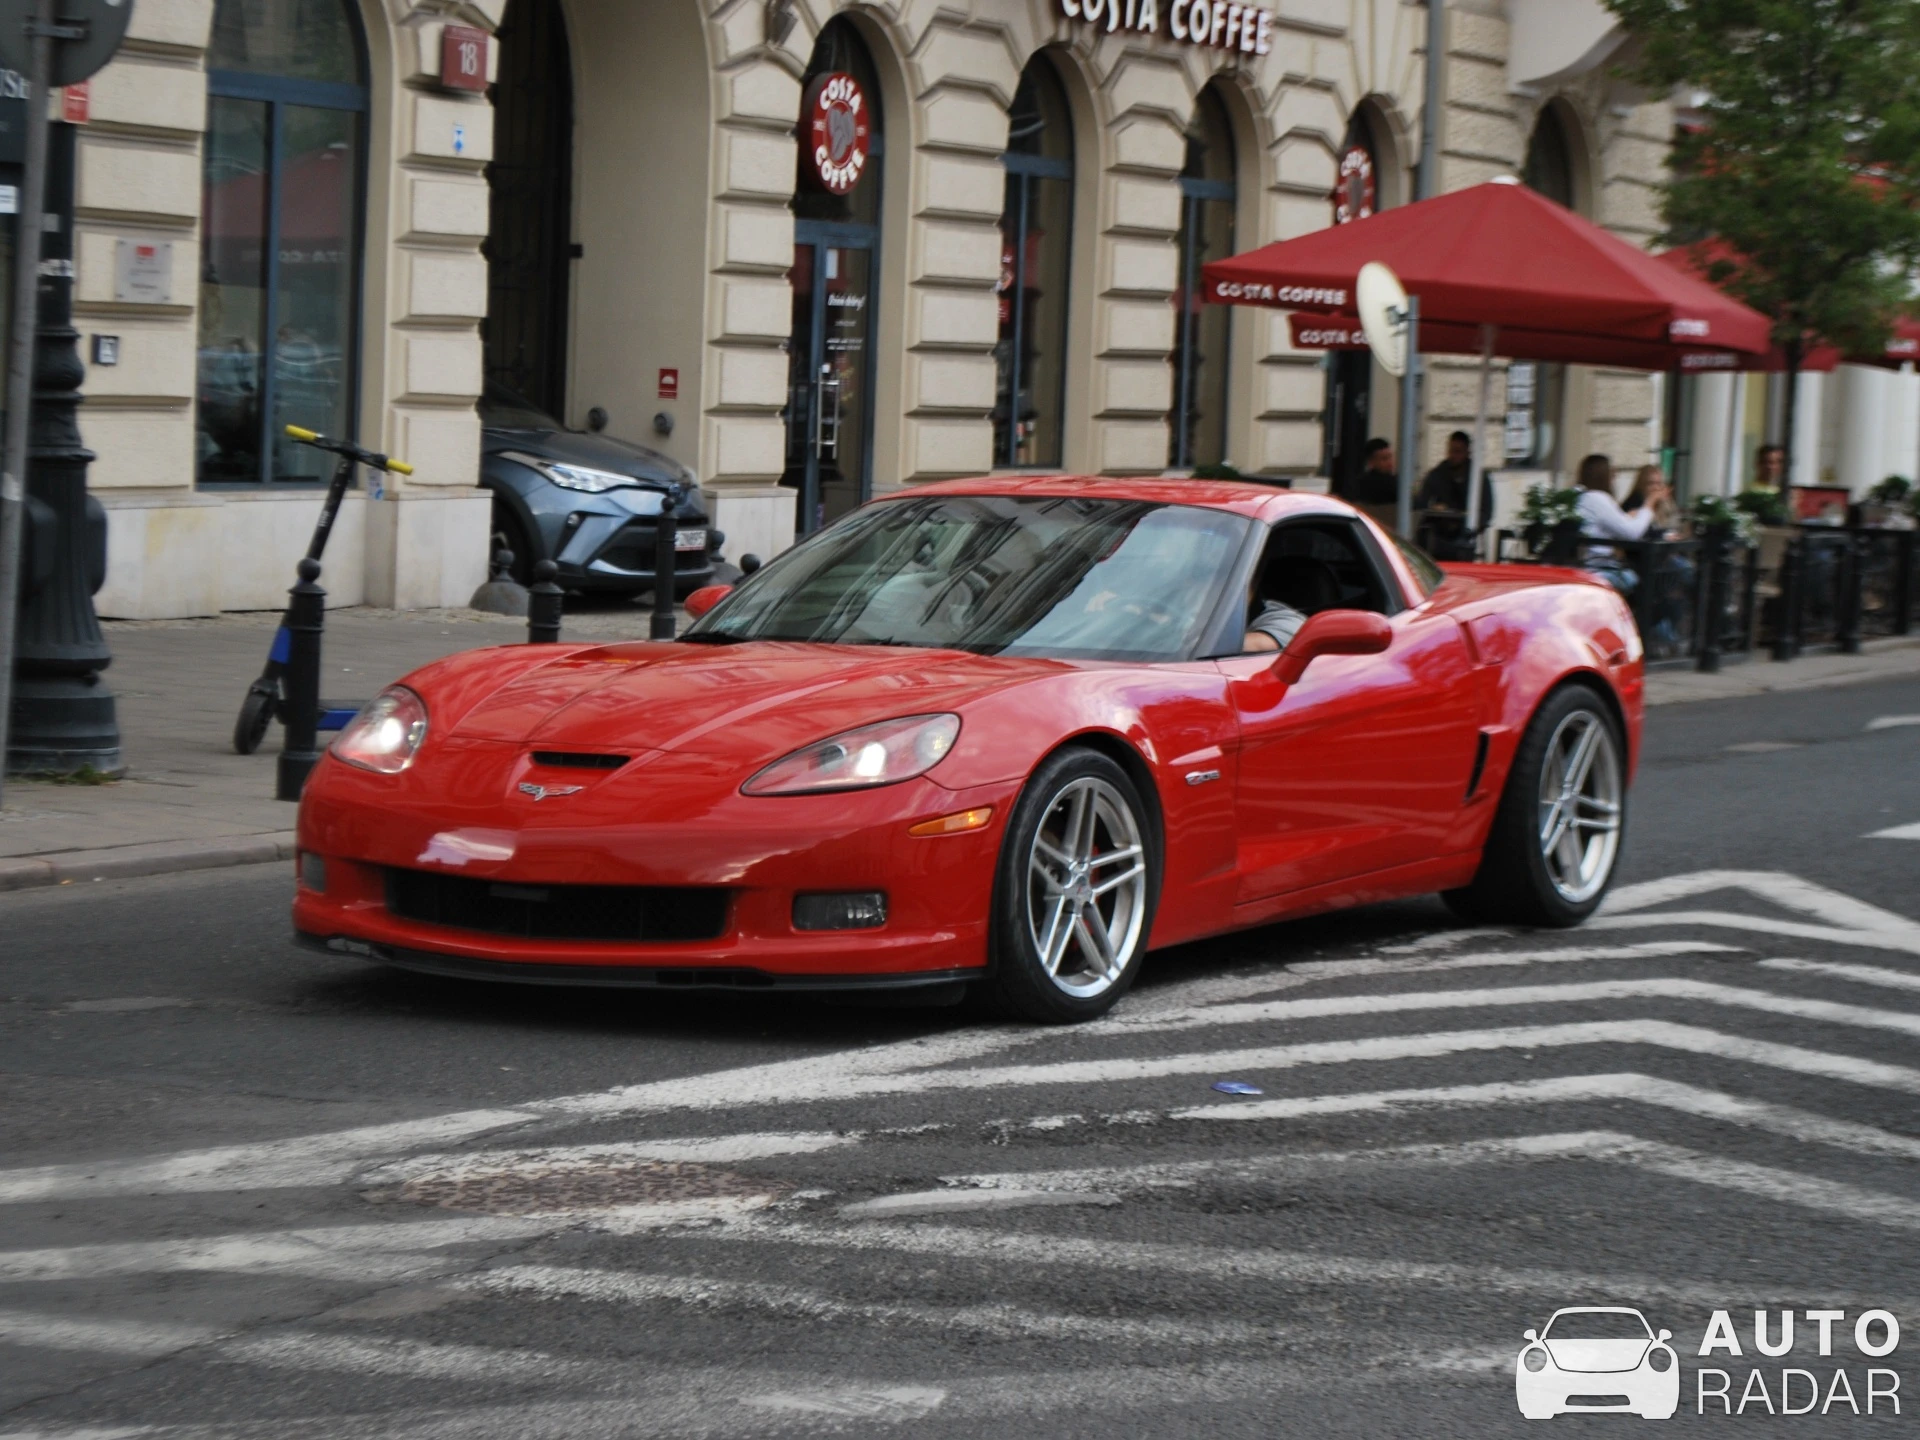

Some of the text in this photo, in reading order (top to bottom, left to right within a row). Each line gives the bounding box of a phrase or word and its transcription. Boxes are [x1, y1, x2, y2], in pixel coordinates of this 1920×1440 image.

[1170, 0, 1272, 54] COFFEE
[458, 42, 478, 76] 18
[820, 77, 862, 115] COSTA
[815, 145, 865, 189] COFFEE
[1216, 282, 1347, 305] COSTA COFFEE
[1300, 330, 1347, 344] COSTA
